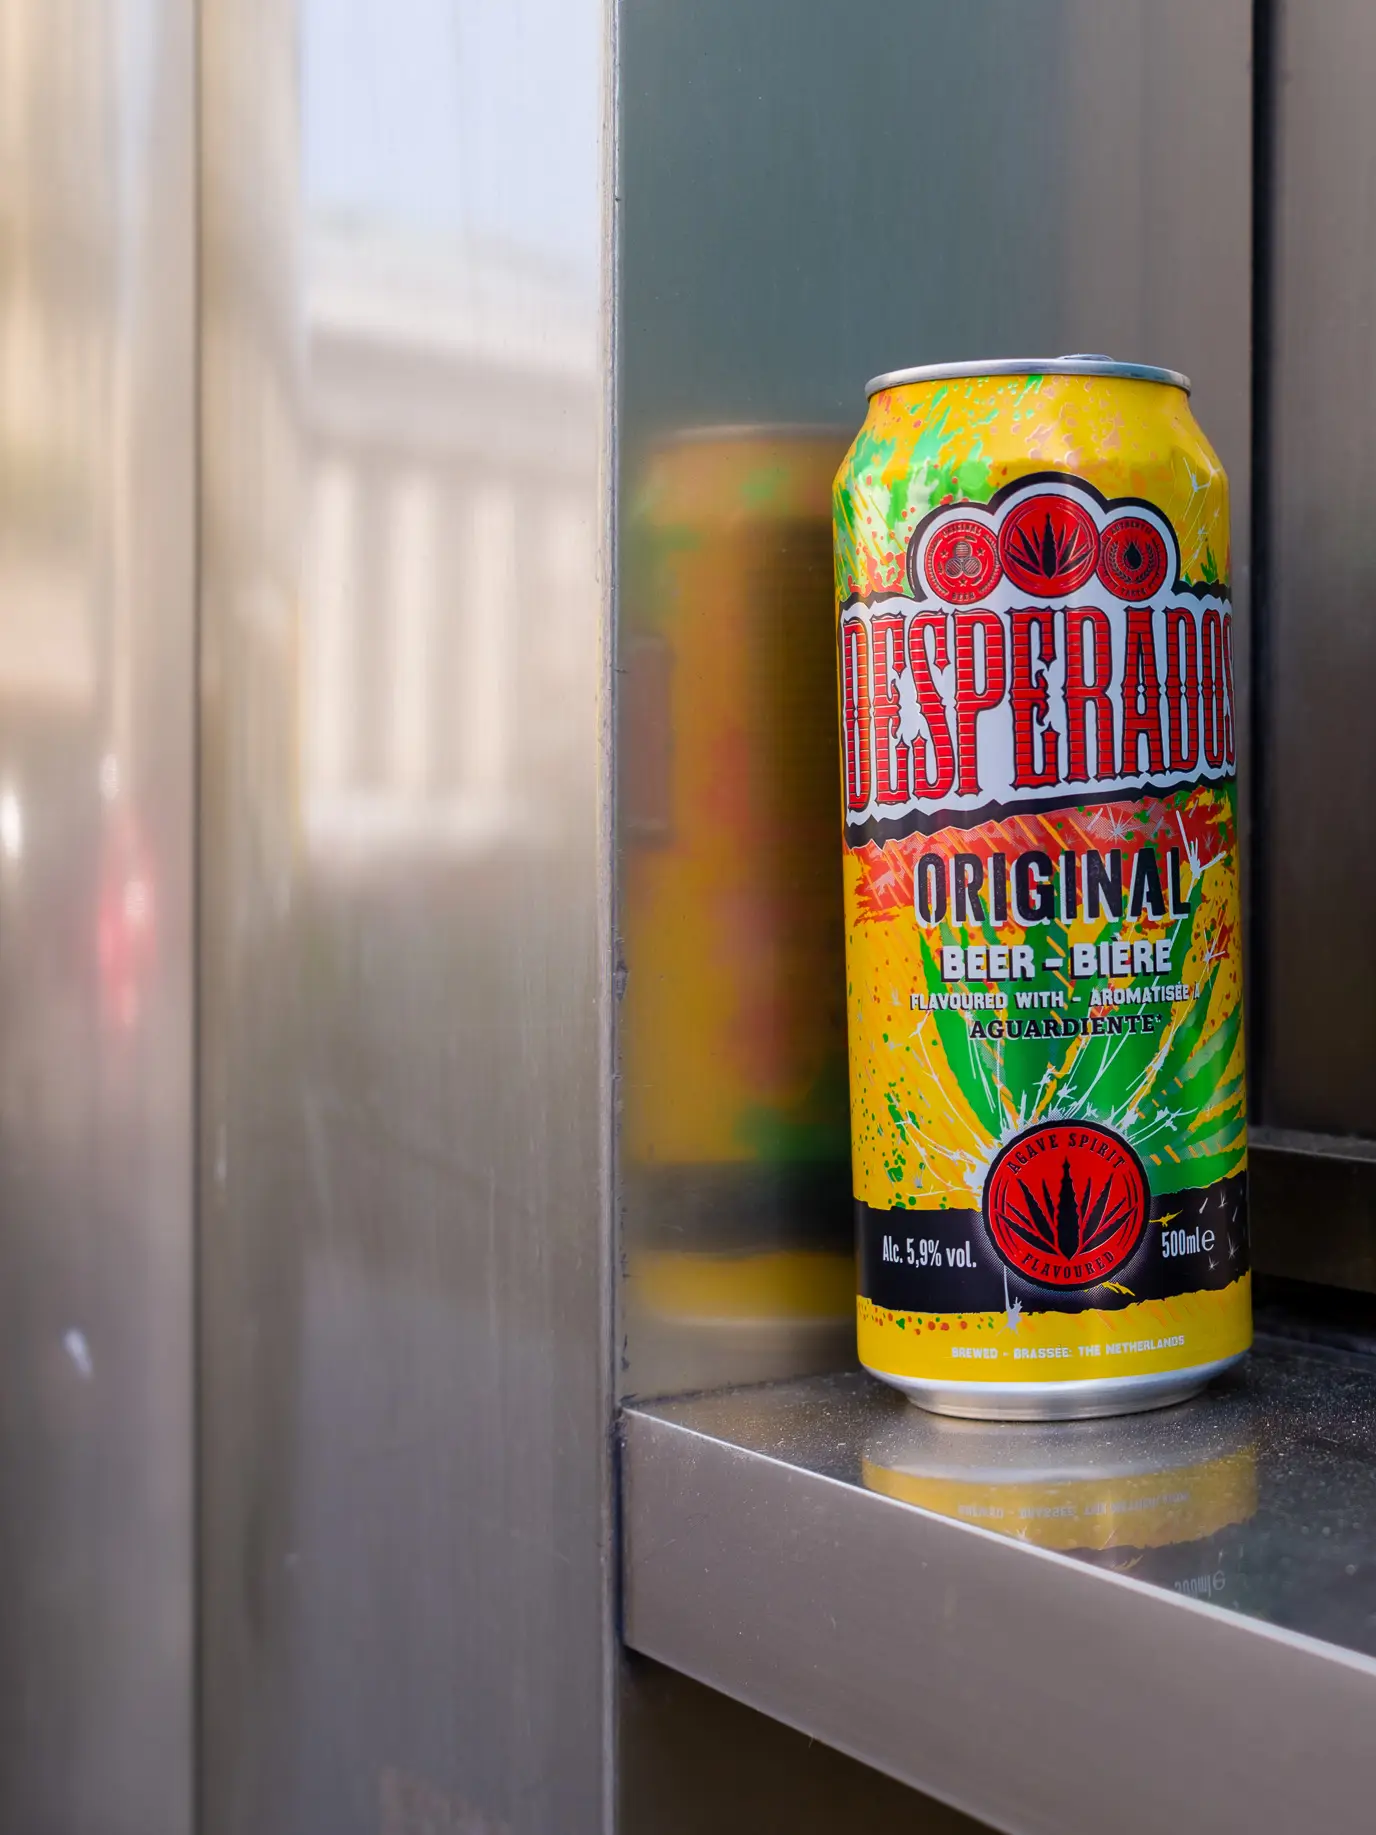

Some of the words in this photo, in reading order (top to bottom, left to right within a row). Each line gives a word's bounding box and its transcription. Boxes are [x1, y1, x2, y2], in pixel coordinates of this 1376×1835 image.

[842, 606, 1235, 811] DESPERADOS
[914, 846, 1191, 927] ORIGINAL
[940, 945, 1035, 982] BEER
[1071, 932, 1172, 979] BIÈRE
[910, 992, 1008, 1010] FLAVOURED
[1015, 991, 1064, 1009] WITH
[1089, 981, 1190, 1006] AROMATISÉE
[1007, 1133, 1059, 1175] AGAVE
[1068, 1133, 1126, 1169] SPIRIT
[883, 1235, 903, 1263] Alc.
[906, 1237, 942, 1268] 5,9%
[945, 1240, 977, 1268] vol.
[1022, 1251, 1115, 1279] FLAVOURED
[951, 1347, 998, 1359] BREWED
[1078, 1346, 1101, 1357] THE
[1106, 1335, 1184, 1355] NETHERLANDS
